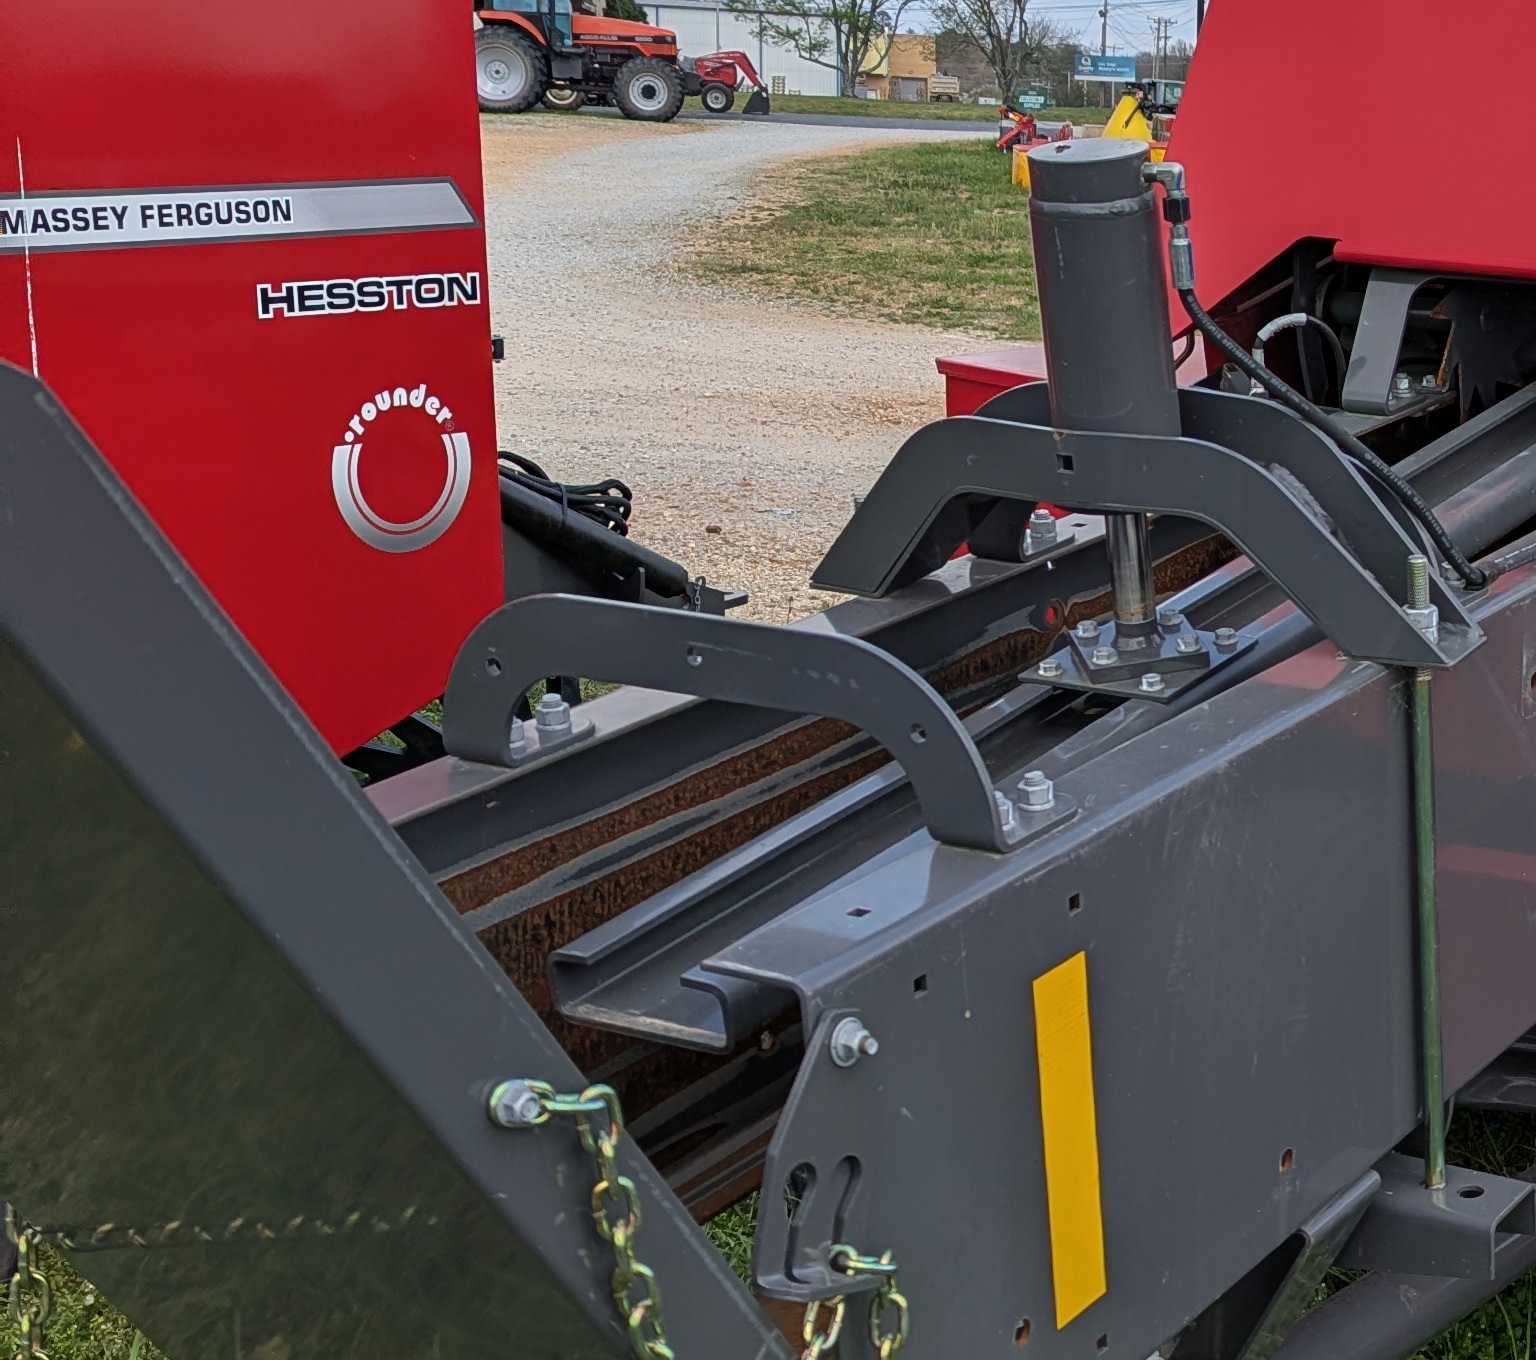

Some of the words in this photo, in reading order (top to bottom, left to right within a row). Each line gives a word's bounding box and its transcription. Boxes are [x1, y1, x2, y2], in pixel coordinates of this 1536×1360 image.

[0, 205, 129, 235] MASSEY
[140, 197, 293, 229] FERGUSON
[257, 273, 481, 318] HESSTON
